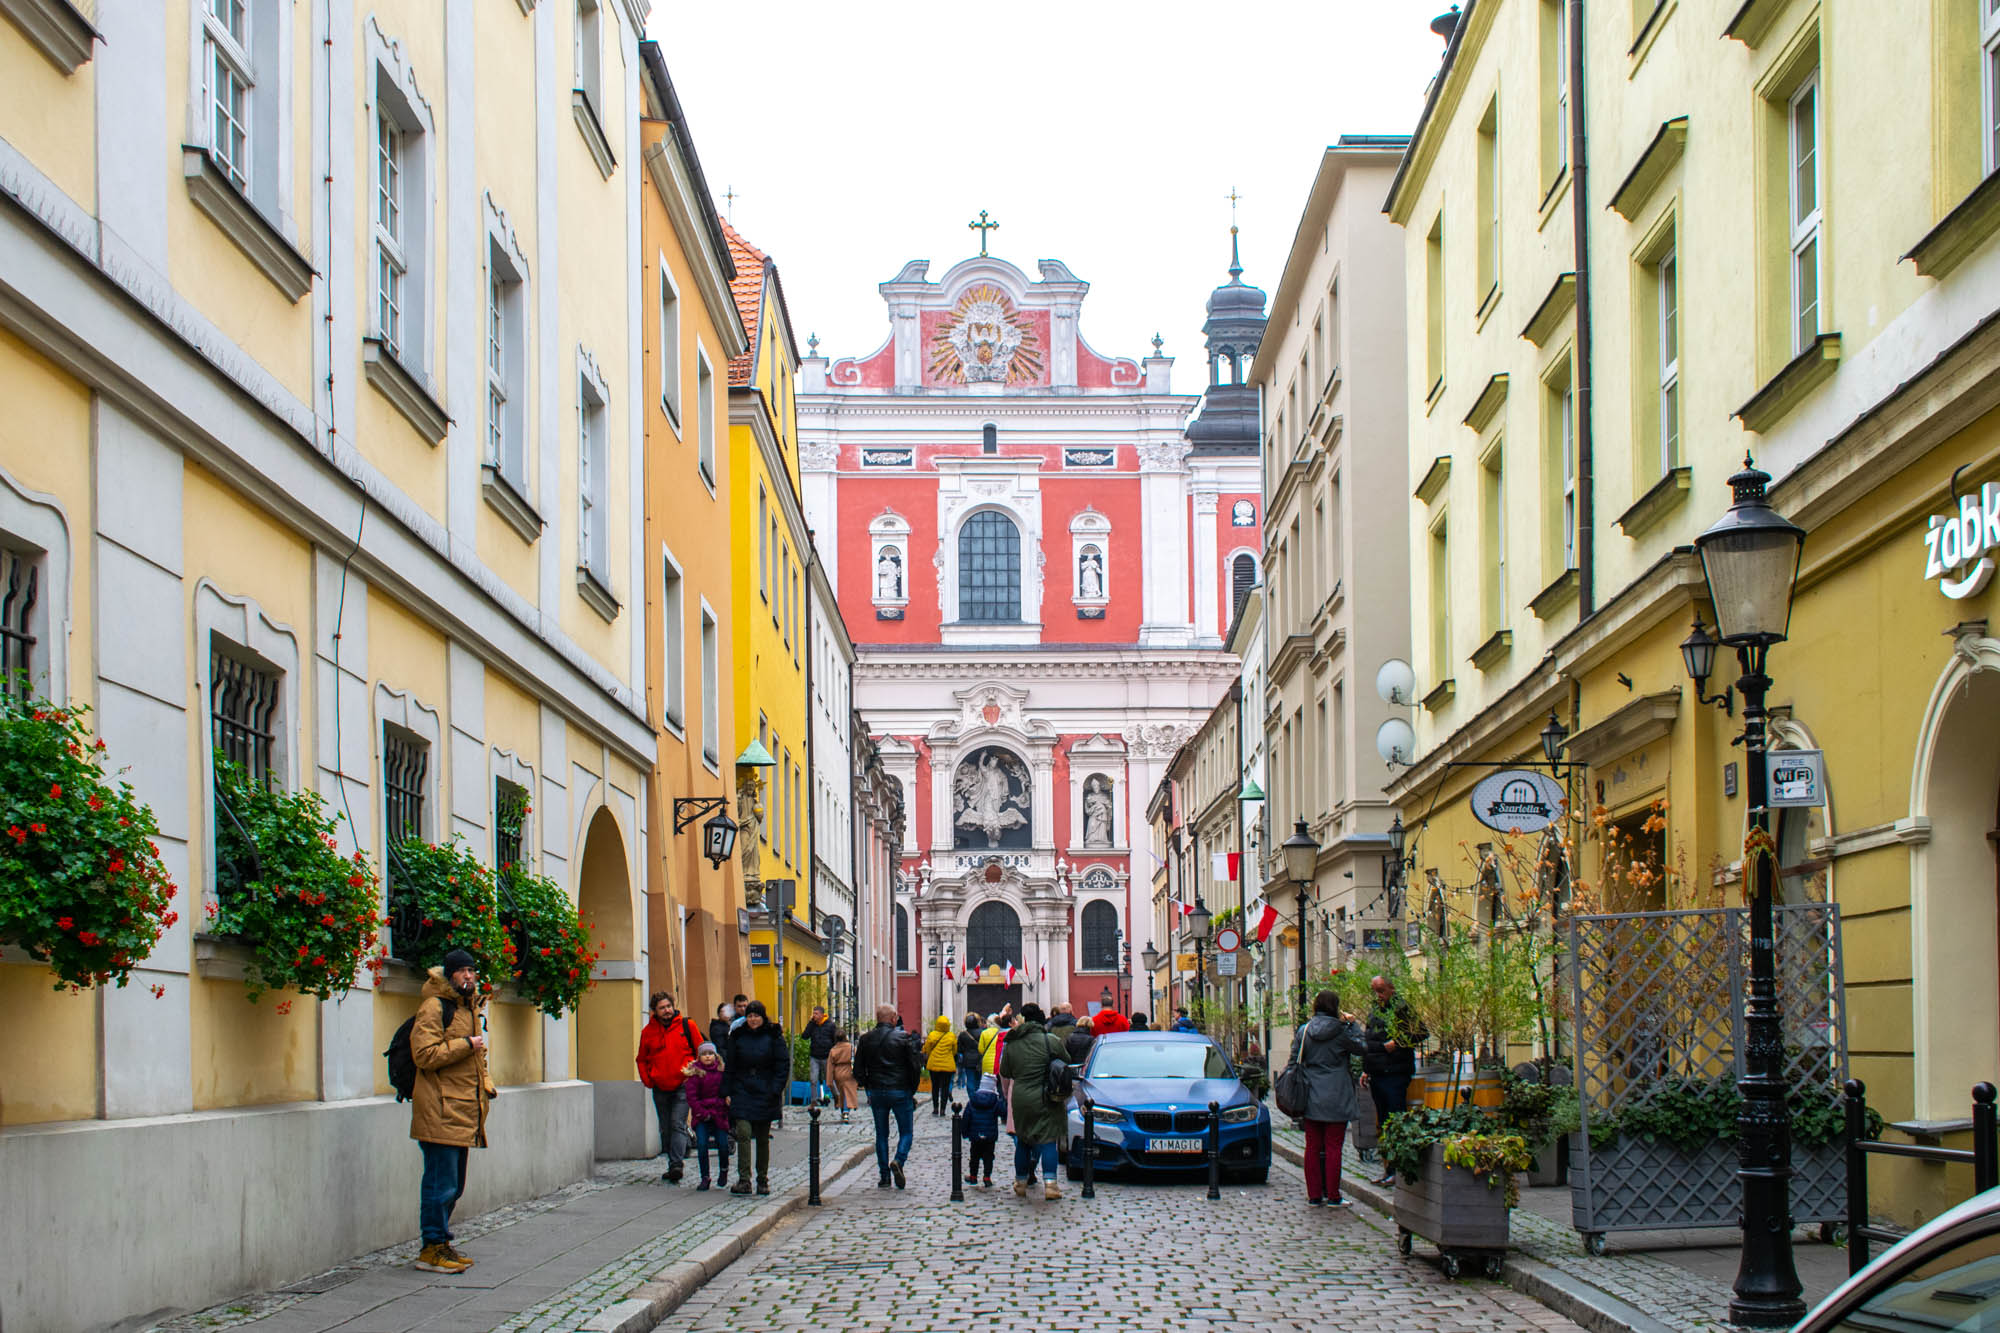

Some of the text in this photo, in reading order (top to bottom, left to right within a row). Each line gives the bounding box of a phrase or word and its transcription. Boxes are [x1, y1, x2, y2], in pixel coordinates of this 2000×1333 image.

[1781, 759, 1805, 767] FREE
[1498, 803, 1540, 813] Szarlotta
[713, 832, 721, 845] 2
[1167, 1140, 1200, 1150] MAGIC
